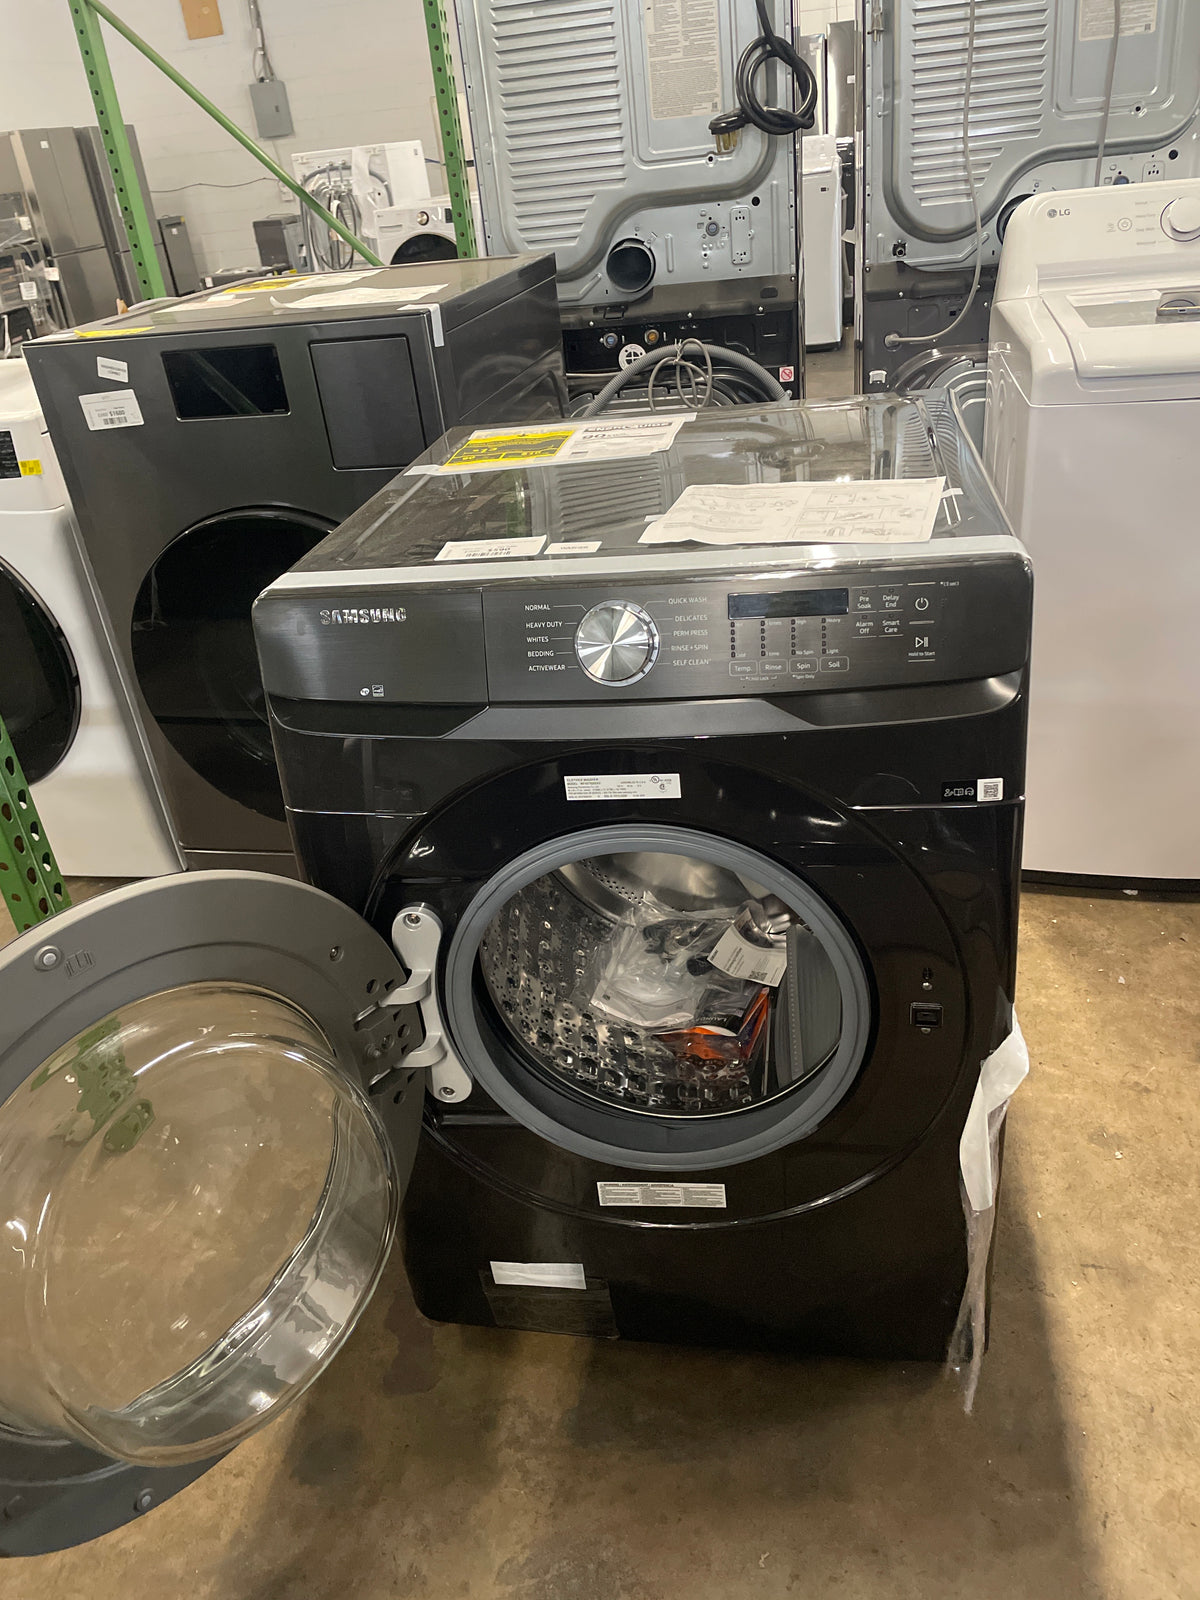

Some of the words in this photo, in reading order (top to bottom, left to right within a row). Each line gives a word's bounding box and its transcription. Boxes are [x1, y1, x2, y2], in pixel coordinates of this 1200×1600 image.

[1058, 208, 1070, 216] LG
[320, 608, 406, 625] SAMSUNG
[674, 614, 708, 622] DELICATES
[528, 664, 566, 672] ACTIVEWEAR
[796, 662, 810, 670] Spin
